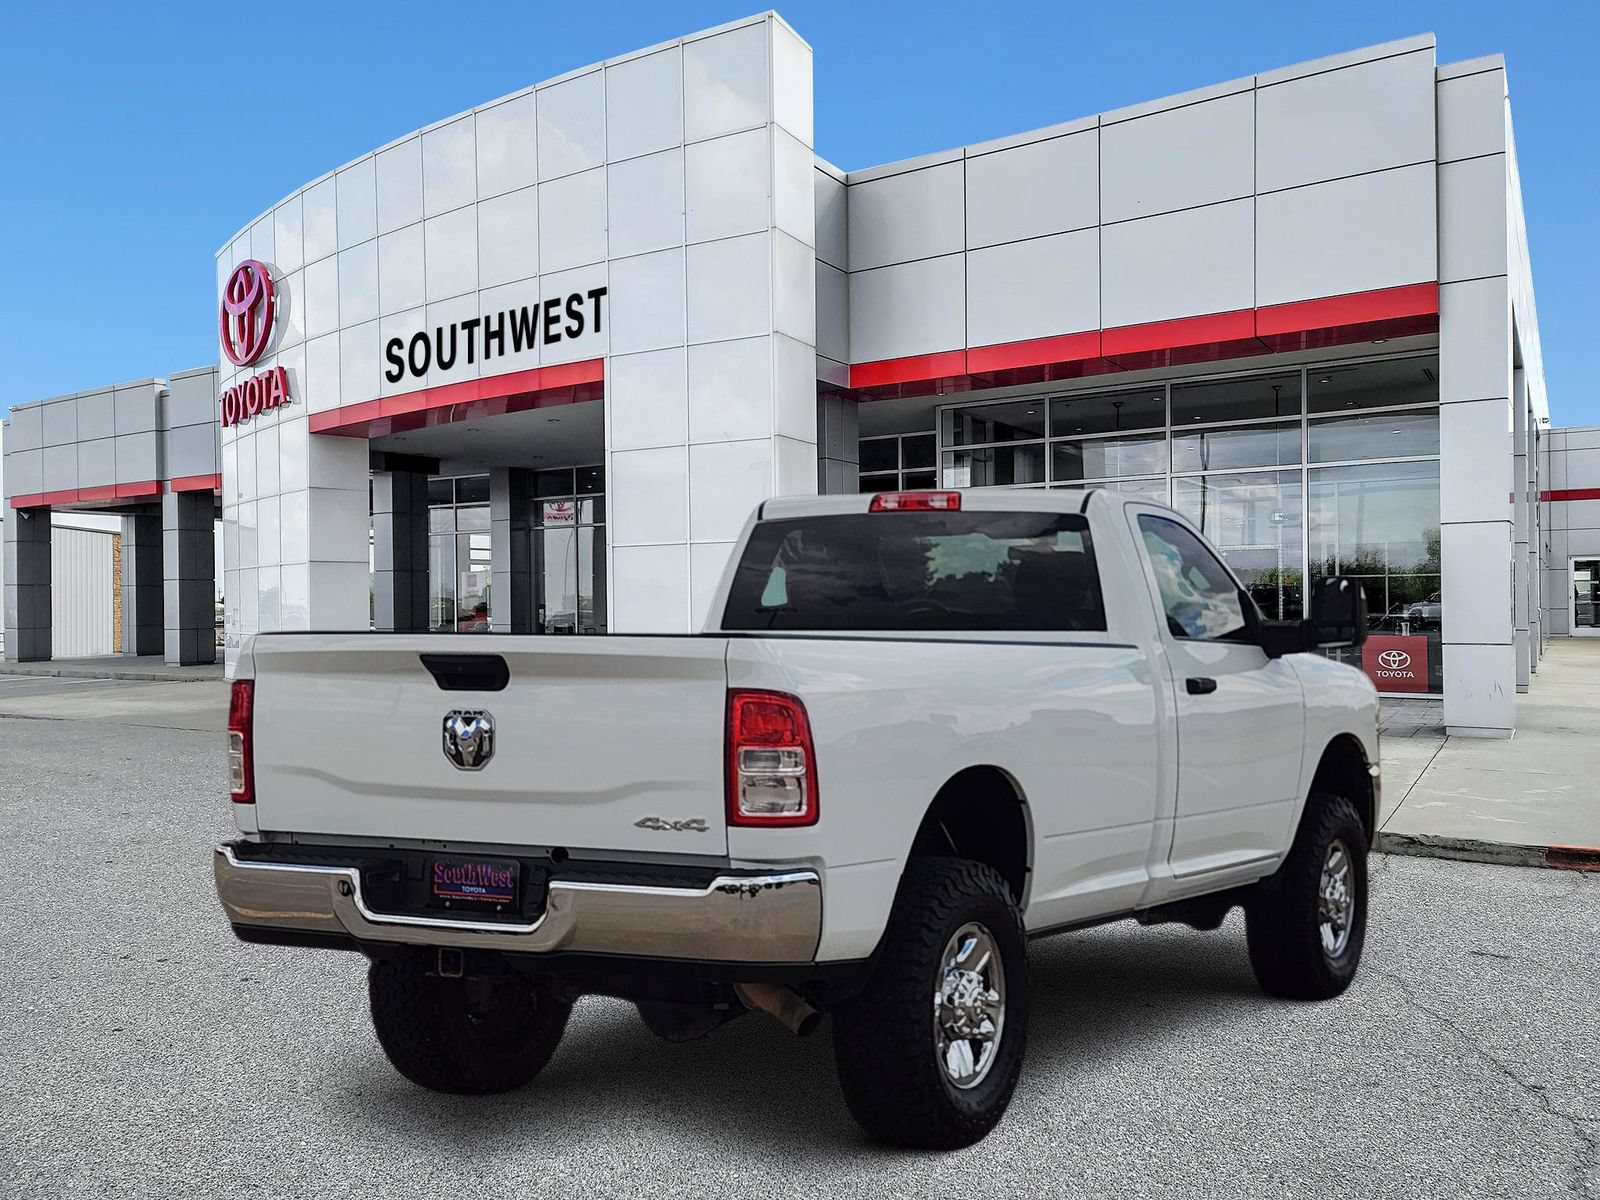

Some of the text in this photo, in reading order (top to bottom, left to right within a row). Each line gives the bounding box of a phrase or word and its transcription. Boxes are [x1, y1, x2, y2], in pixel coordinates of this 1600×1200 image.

[385, 286, 608, 384] SOUTHWEST
[218, 365, 290, 428] TOYOTA
[1375, 670, 1415, 678] TOYOTA
[461, 885, 487, 894] TOYOTA
